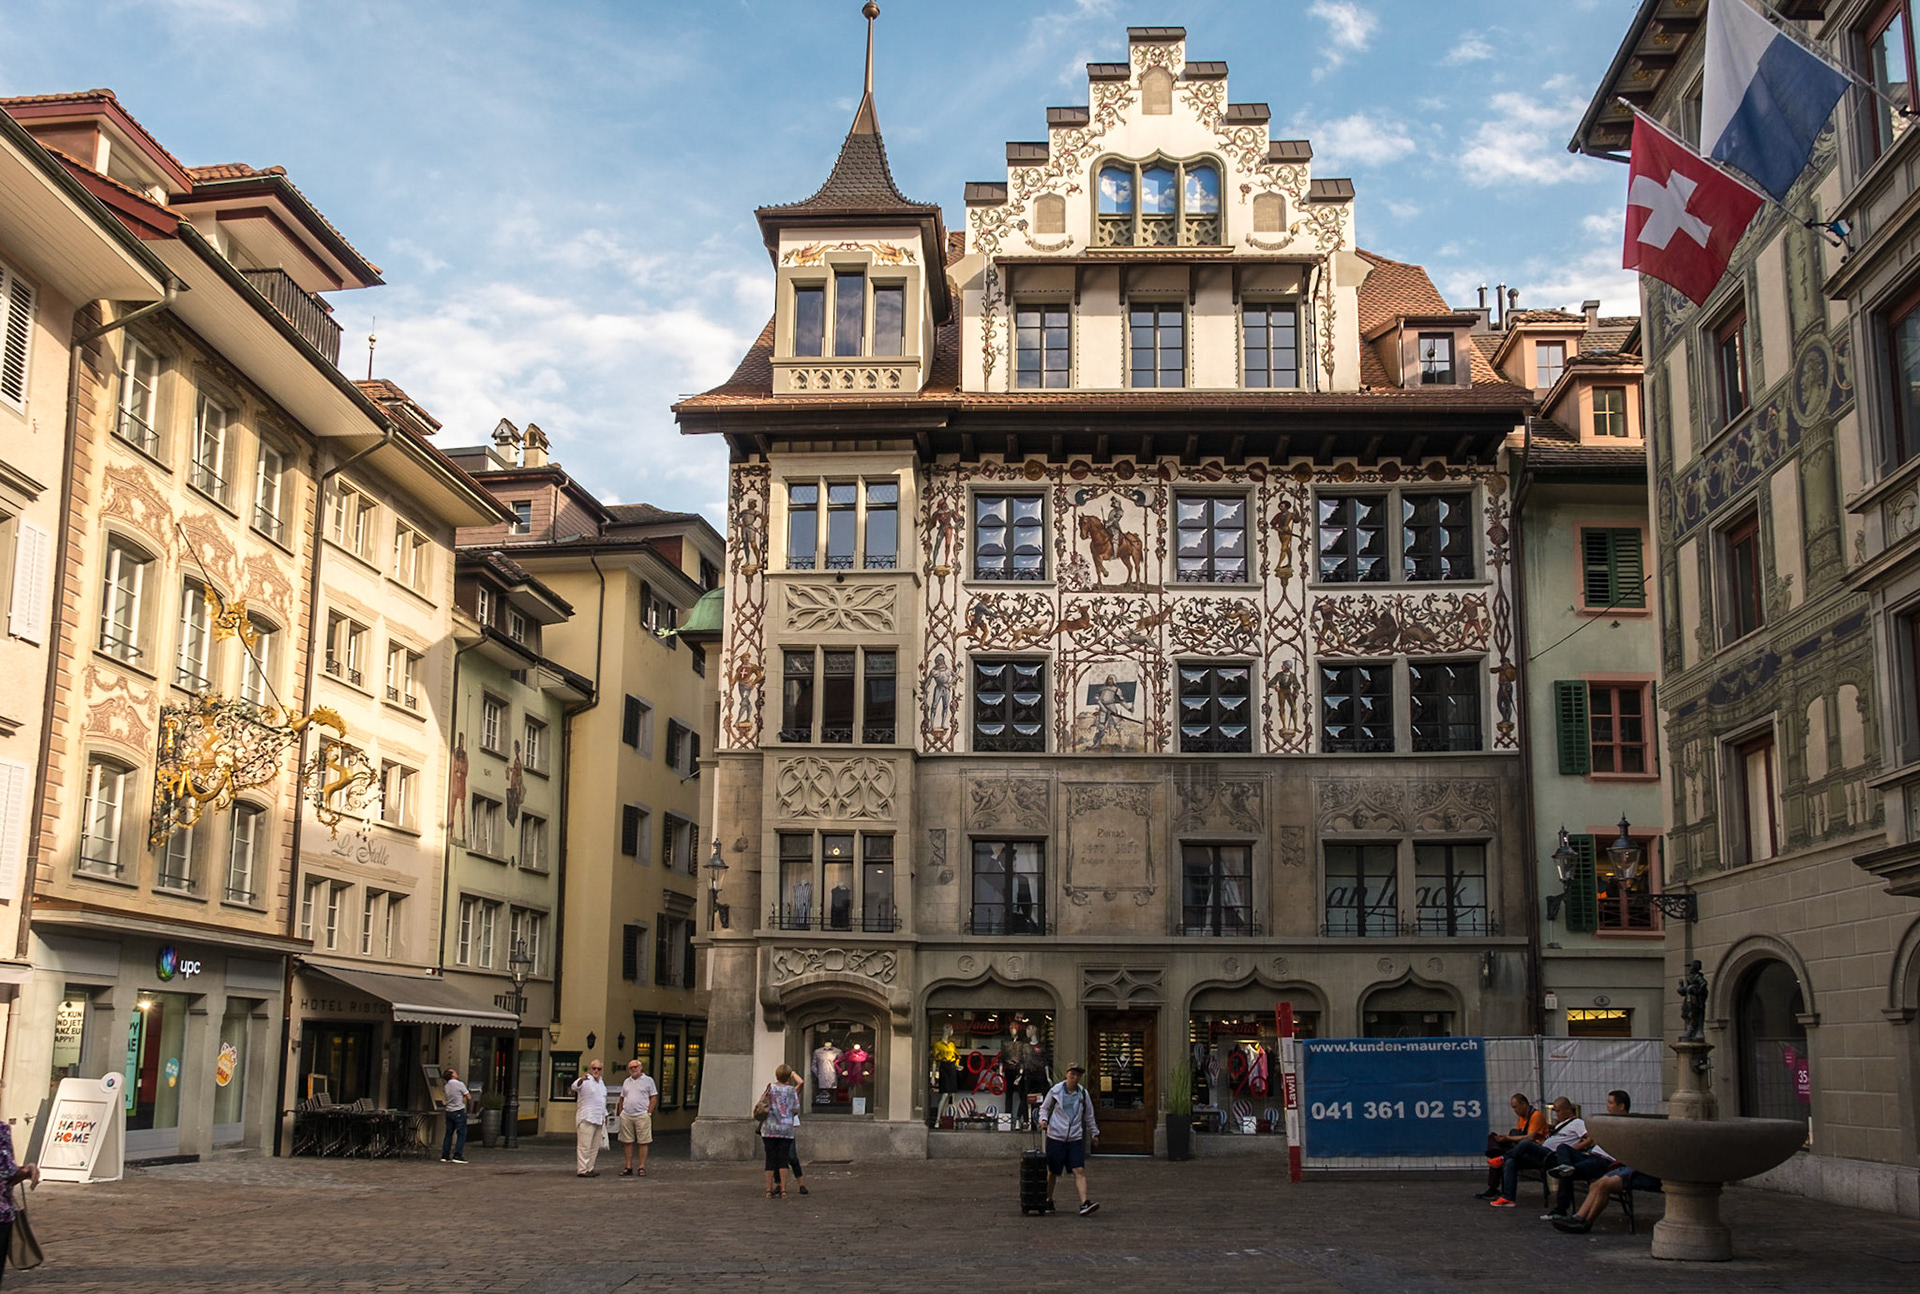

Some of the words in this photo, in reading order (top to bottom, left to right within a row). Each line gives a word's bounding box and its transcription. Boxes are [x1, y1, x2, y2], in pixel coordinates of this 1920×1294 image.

[331, 834, 354, 857] Le
[356, 840, 390, 866] Stelle
[180, 960, 201, 979] upc
[301, 998, 344, 1012] HOTEL
[1309, 1039, 1479, 1053] www.kunden-maurer.ch
[1797, 1070, 1808, 1083] 35
[1285, 1075, 1298, 1109] Lawil
[1311, 1102, 1354, 1120] 041
[1363, 1101, 1405, 1119] 361
[1414, 1101, 1445, 1119] 02
[1452, 1100, 1482, 1118] 53
[58, 1120, 97, 1132] HAPPY
